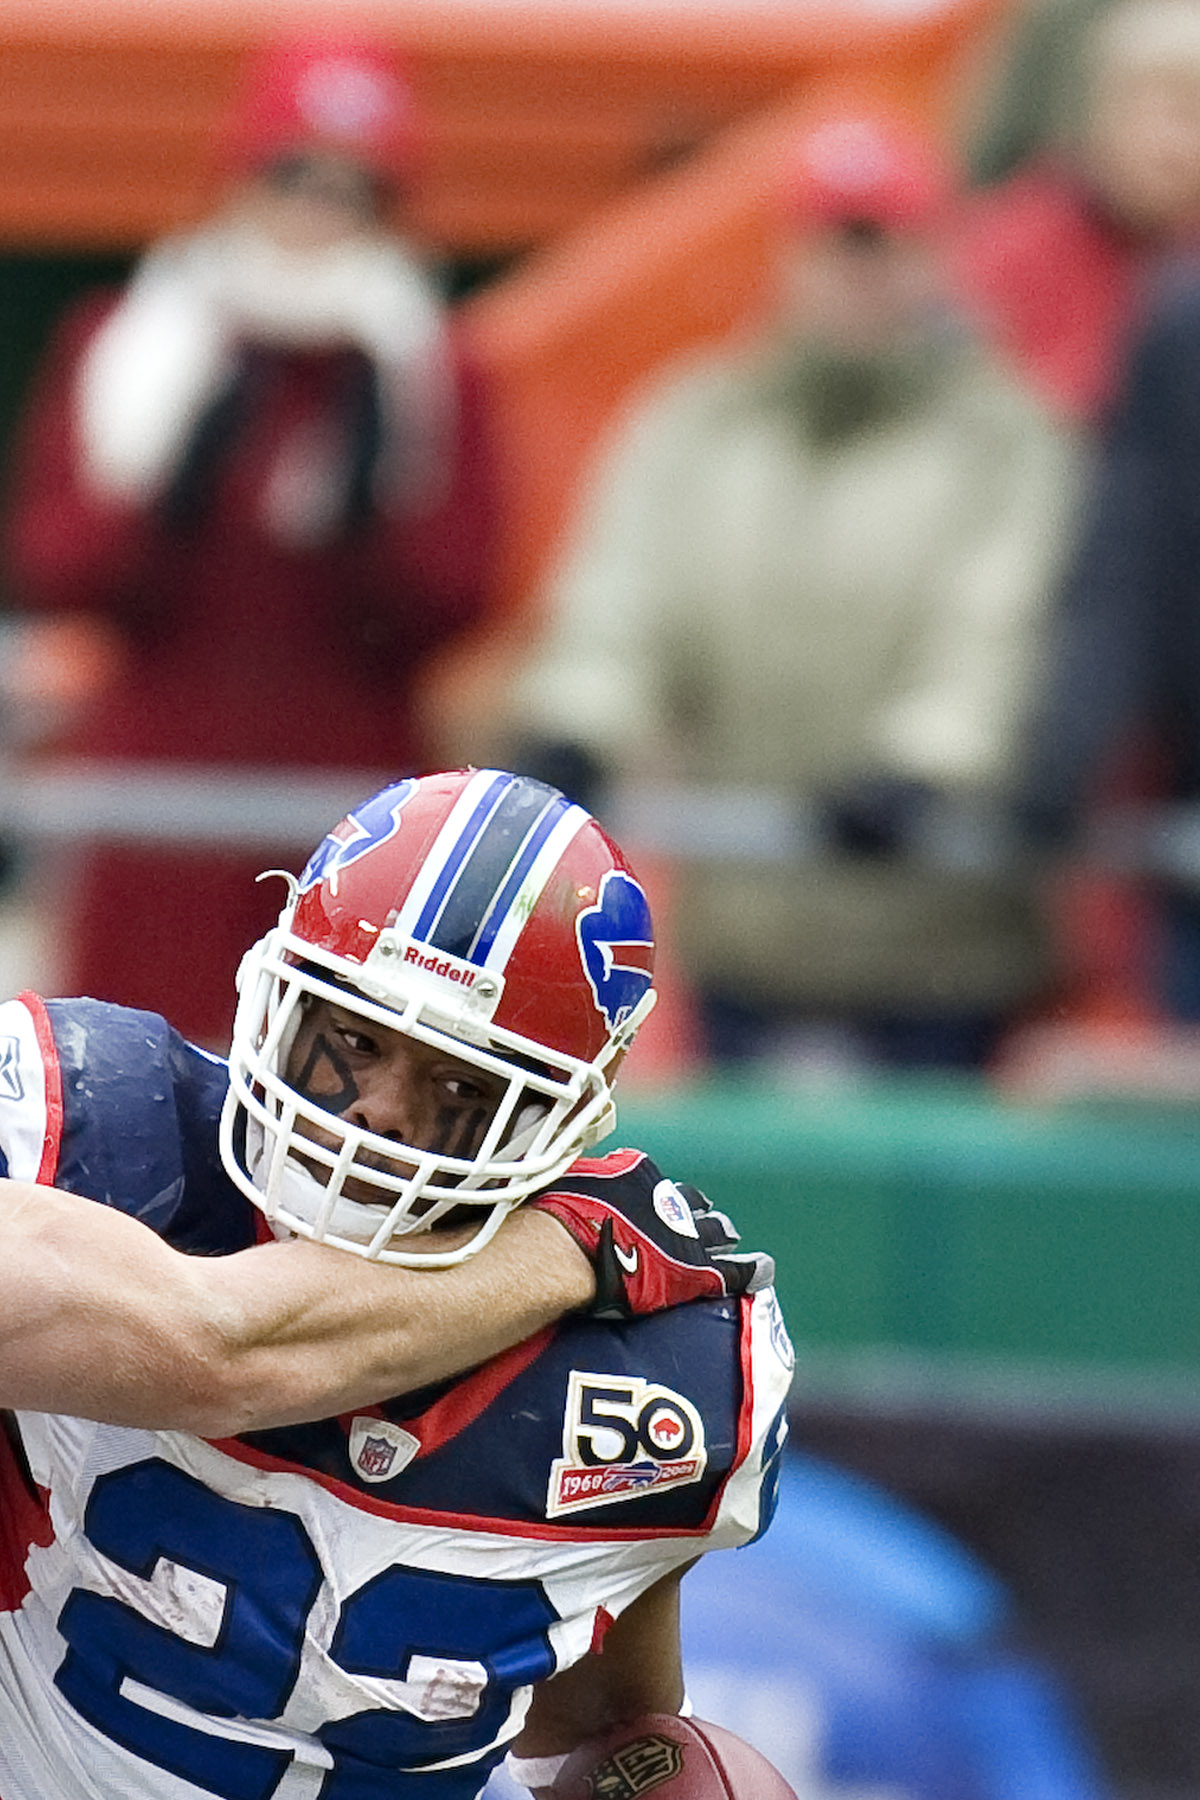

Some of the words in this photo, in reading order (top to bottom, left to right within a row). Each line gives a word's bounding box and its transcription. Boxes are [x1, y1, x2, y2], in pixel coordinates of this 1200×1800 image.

[403, 946, 476, 988] Riddell
[576, 1385, 695, 1467] 50
[619, 1741, 671, 1788] NFL
